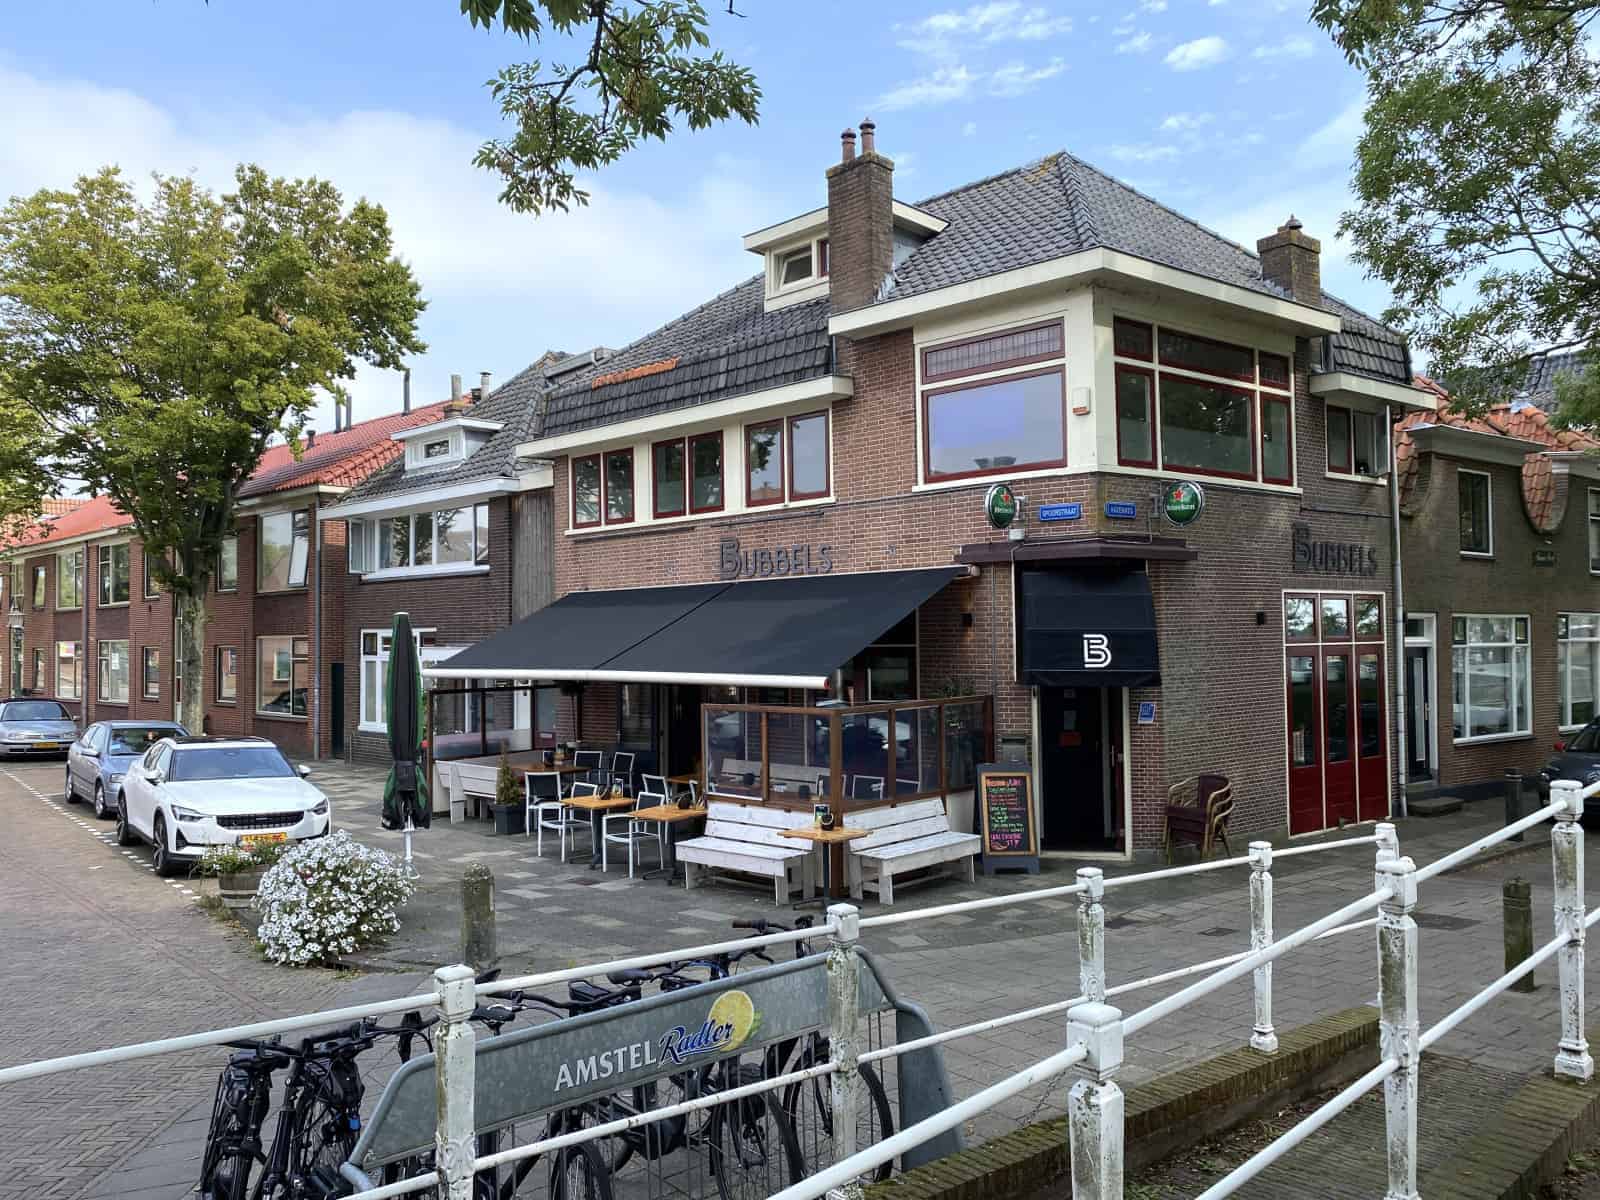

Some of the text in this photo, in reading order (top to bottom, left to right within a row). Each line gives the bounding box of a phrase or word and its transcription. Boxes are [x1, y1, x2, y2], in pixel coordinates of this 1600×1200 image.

[720, 539, 832, 579] BUBBELS
[1083, 634, 1112, 668] B
[554, 1019, 734, 1092] AMSTEL Radler
